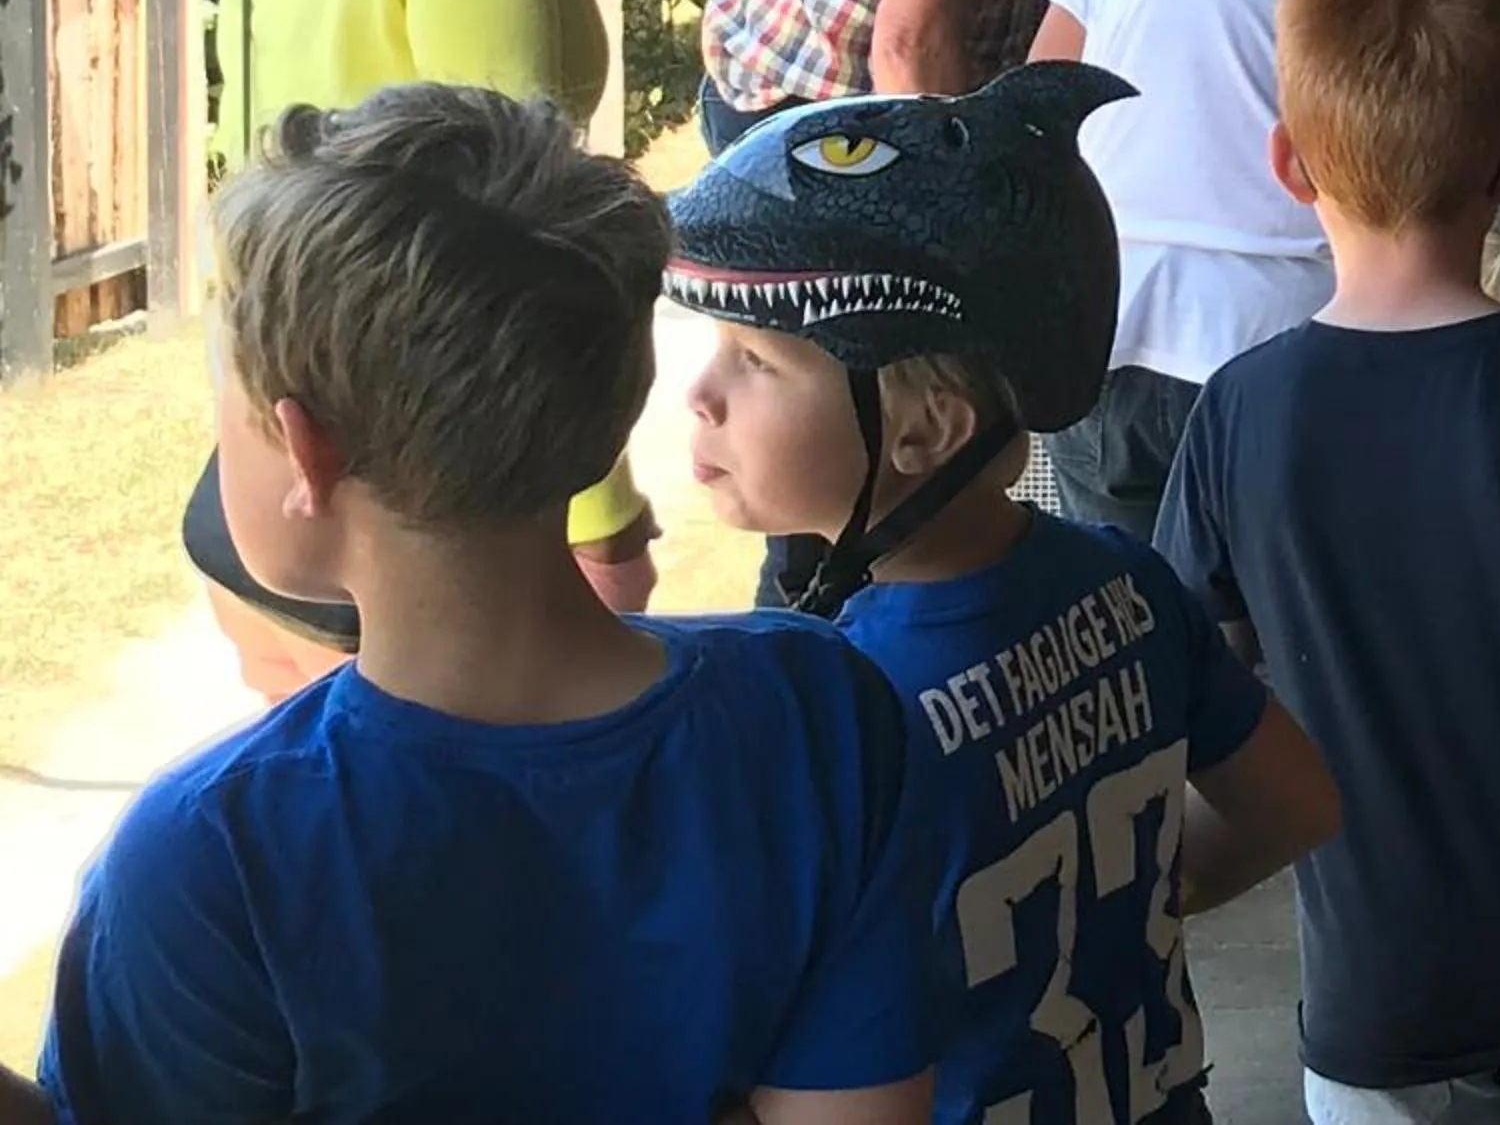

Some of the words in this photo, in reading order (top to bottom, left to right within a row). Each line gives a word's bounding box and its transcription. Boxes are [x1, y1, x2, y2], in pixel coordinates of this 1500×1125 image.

[918, 661, 1005, 756] DET
[994, 593, 1116, 716] FAGLIGE
[994, 659, 1153, 824] MENSAH
